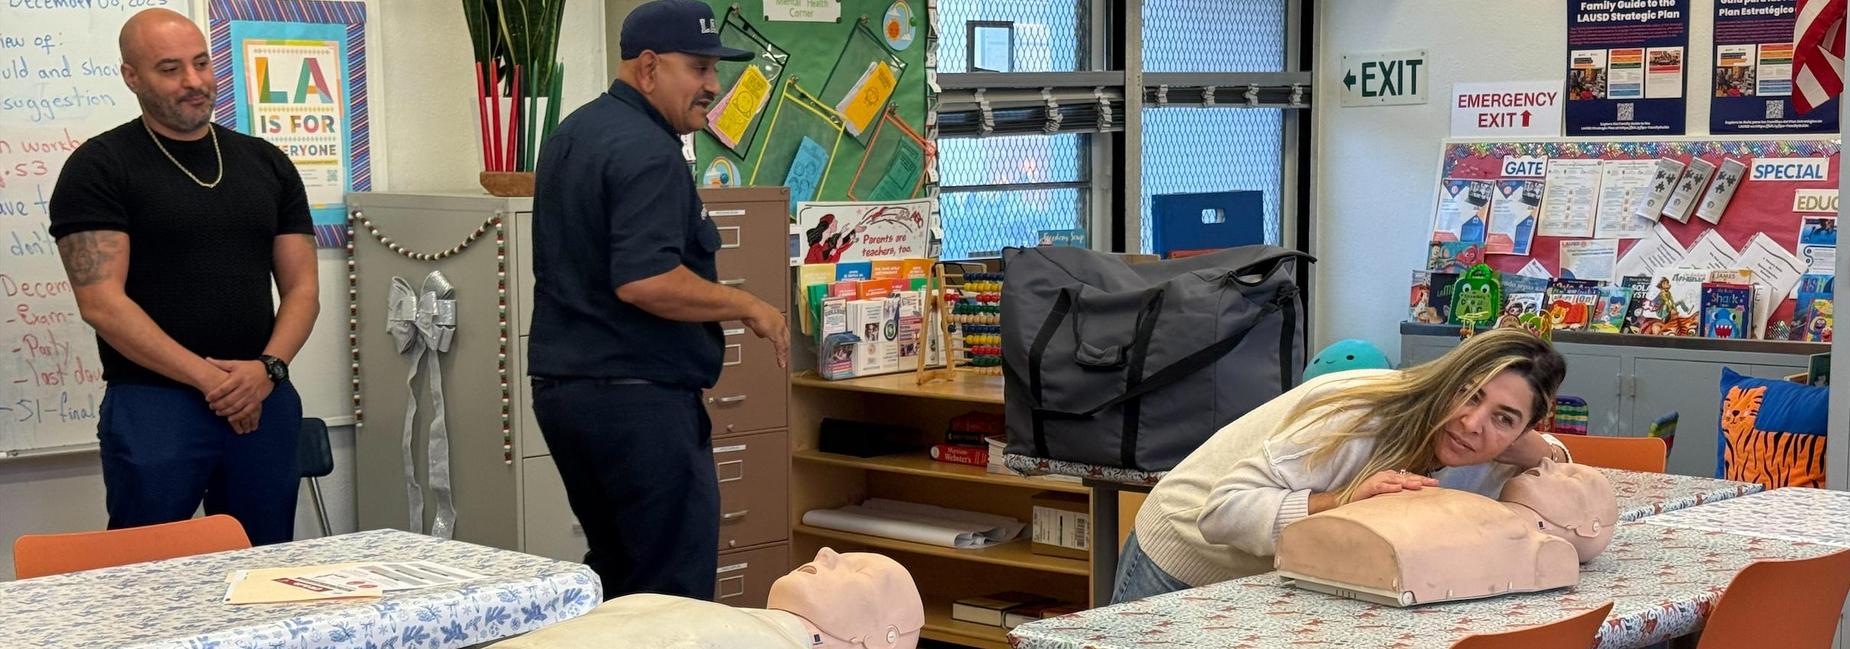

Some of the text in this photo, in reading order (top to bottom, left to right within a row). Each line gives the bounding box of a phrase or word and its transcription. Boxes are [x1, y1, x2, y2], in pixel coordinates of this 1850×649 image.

[1580, 1, 1616, 12] Family
[1617, 0, 1646, 9] Guide
[1647, 0, 1658, 8] to
[1719, 5, 1794, 16] Plan Estratégico
[1577, 10, 1680, 22] LAUSD Strategic Plan
[38, 55, 73, 79] and
[255, 57, 334, 104] LA
[1361, 59, 1423, 97] EXIT
[3, 86, 116, 122] suggestion
[1458, 92, 1558, 108] EMERGENCY
[260, 115, 336, 134] IS FOR
[1478, 112, 1517, 128] EXIT
[1505, 161, 1543, 175] GATE
[1753, 163, 1824, 179] SPECIAL
[863, 233, 894, 244] Parents
[862, 245, 913, 257] teachers, too.
[1711, 292, 1738, 304] Shark
